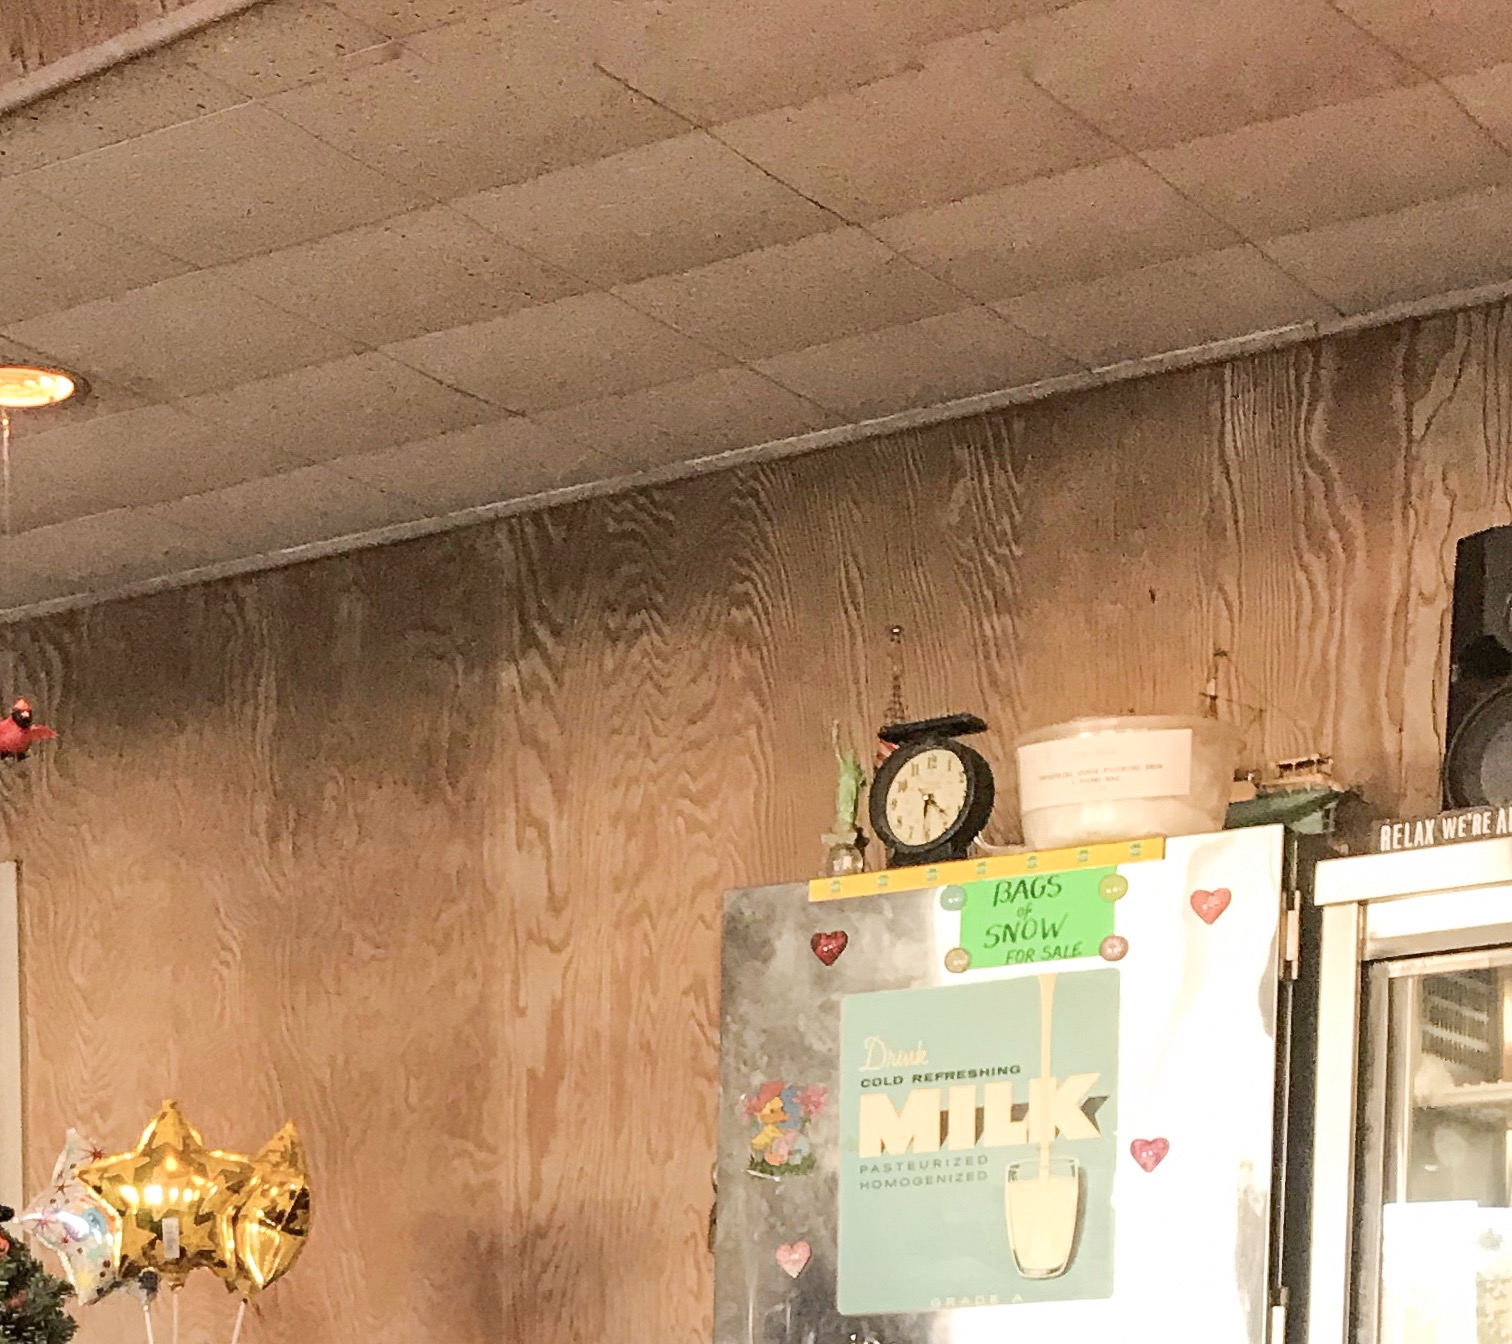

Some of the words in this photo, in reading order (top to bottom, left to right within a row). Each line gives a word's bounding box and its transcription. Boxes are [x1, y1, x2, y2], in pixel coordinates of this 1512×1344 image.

[1380, 818, 1435, 852] RELAX
[1442, 811, 1492, 840] WE'RE
[993, 874, 1062, 907] BAGS
[983, 912, 1069, 949] SNOW
[1005, 948, 1036, 964] FOR
[1041, 940, 1083, 961] SALE
[860, 1075, 904, 1088] COLD
[912, 1064, 1021, 1084] REFRESHING
[859, 1072, 1101, 1158] MILK
[859, 1154, 988, 1174] PASTEURIZED
[859, 1170, 988, 1190] HOMOGENIZED
[930, 1294, 1000, 1307] GRADE
